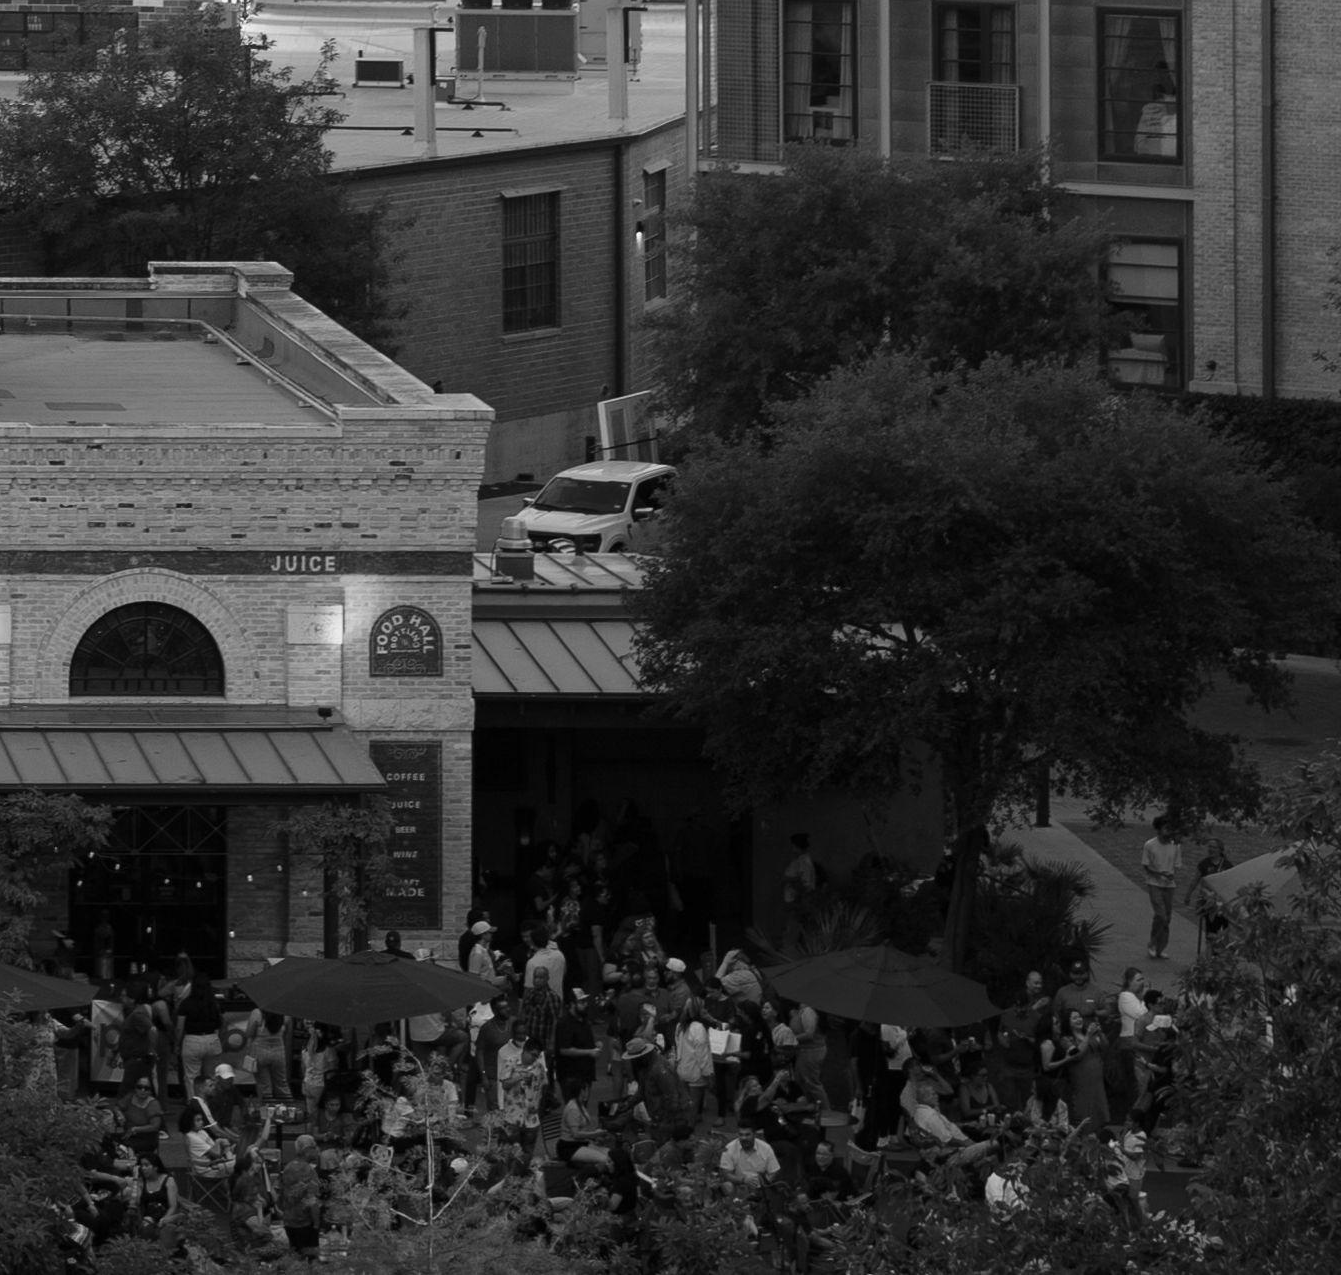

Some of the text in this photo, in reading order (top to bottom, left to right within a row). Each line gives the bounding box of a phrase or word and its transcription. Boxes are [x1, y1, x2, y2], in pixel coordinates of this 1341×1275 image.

[271, 555, 336, 572] JUICE
[377, 614, 434, 654] FOOD HALL
[386, 772, 426, 781] COFFEE
[391, 800, 420, 809] JUICE
[395, 826, 416, 834] BEER
[393, 850, 418, 858] WINE
[386, 887, 425, 897] MADE
